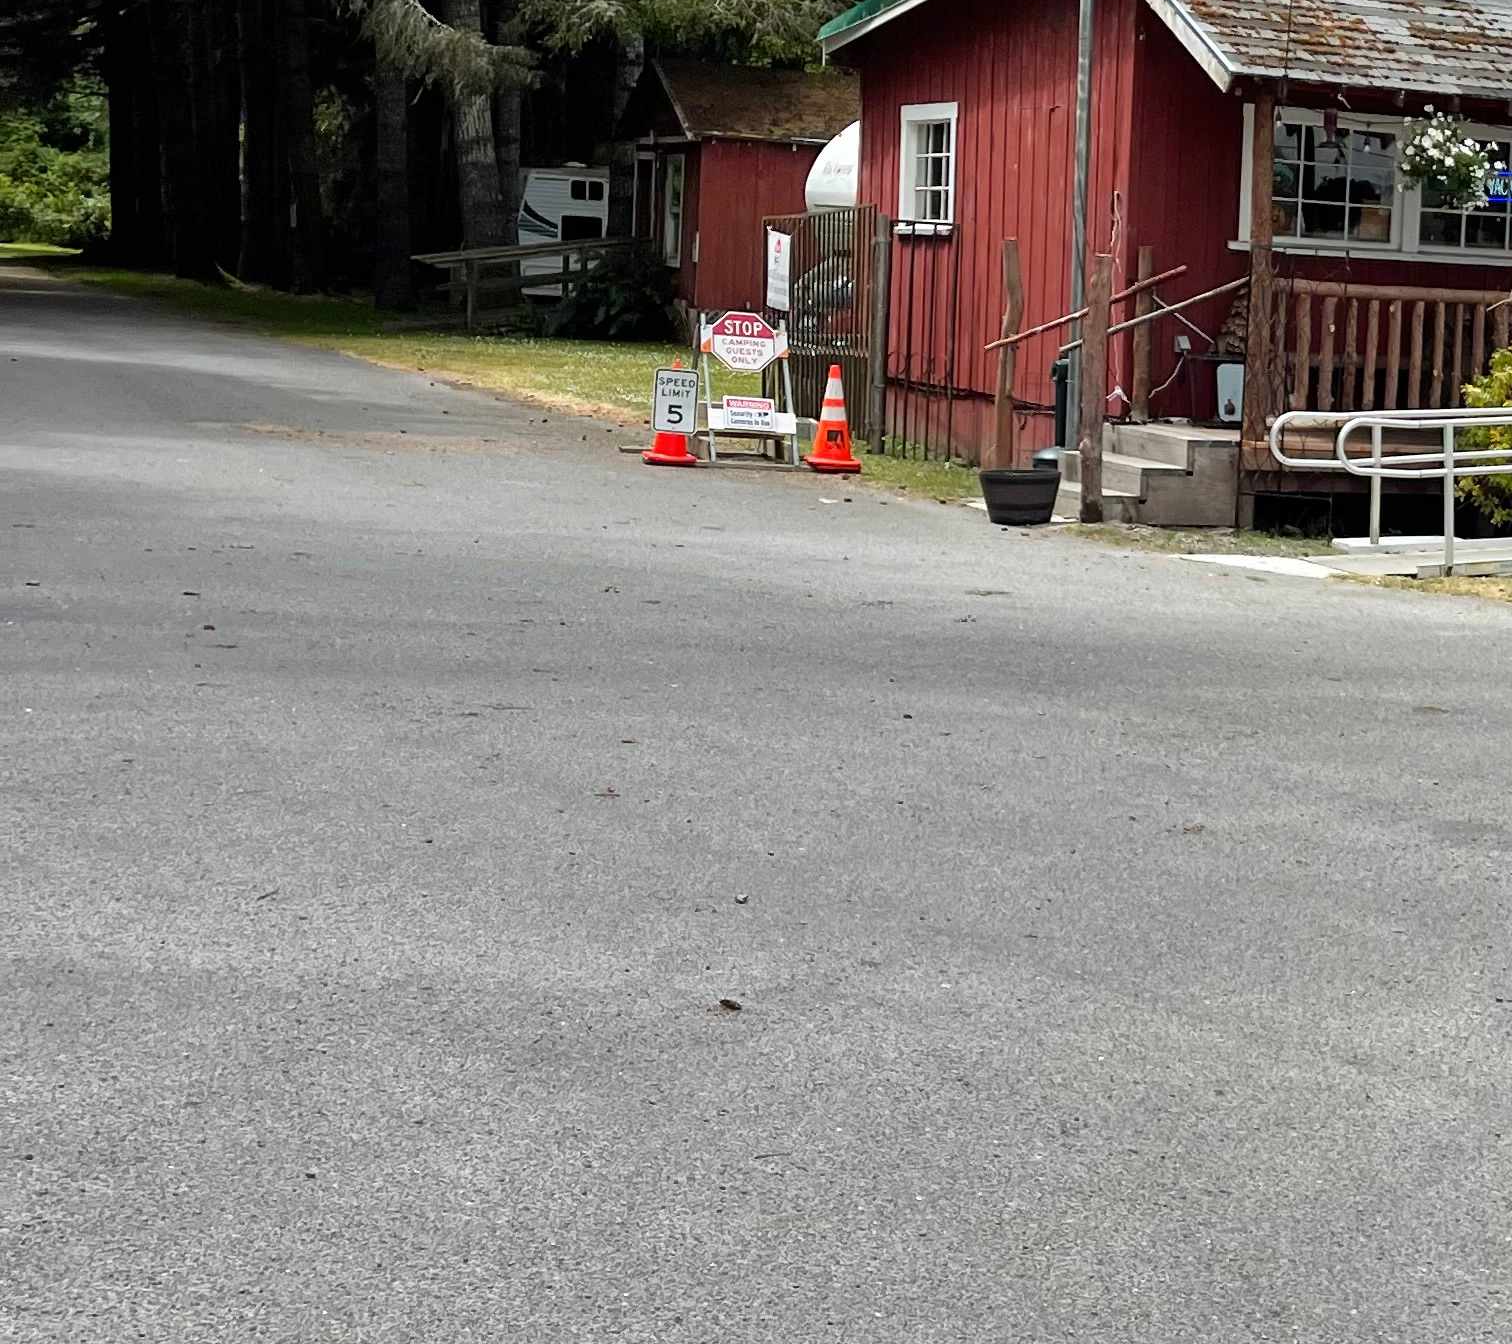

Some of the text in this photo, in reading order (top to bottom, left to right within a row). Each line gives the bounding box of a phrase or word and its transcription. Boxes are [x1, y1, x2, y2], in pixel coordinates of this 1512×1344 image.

[724, 320, 762, 336] STOP
[722, 338, 766, 347] CAMPING
[726, 347, 764, 356] GUESTS
[731, 356, 758, 365] ONLY
[658, 376, 696, 389] SPEED
[661, 387, 691, 398] LIMIT
[667, 404, 683, 424] 5
